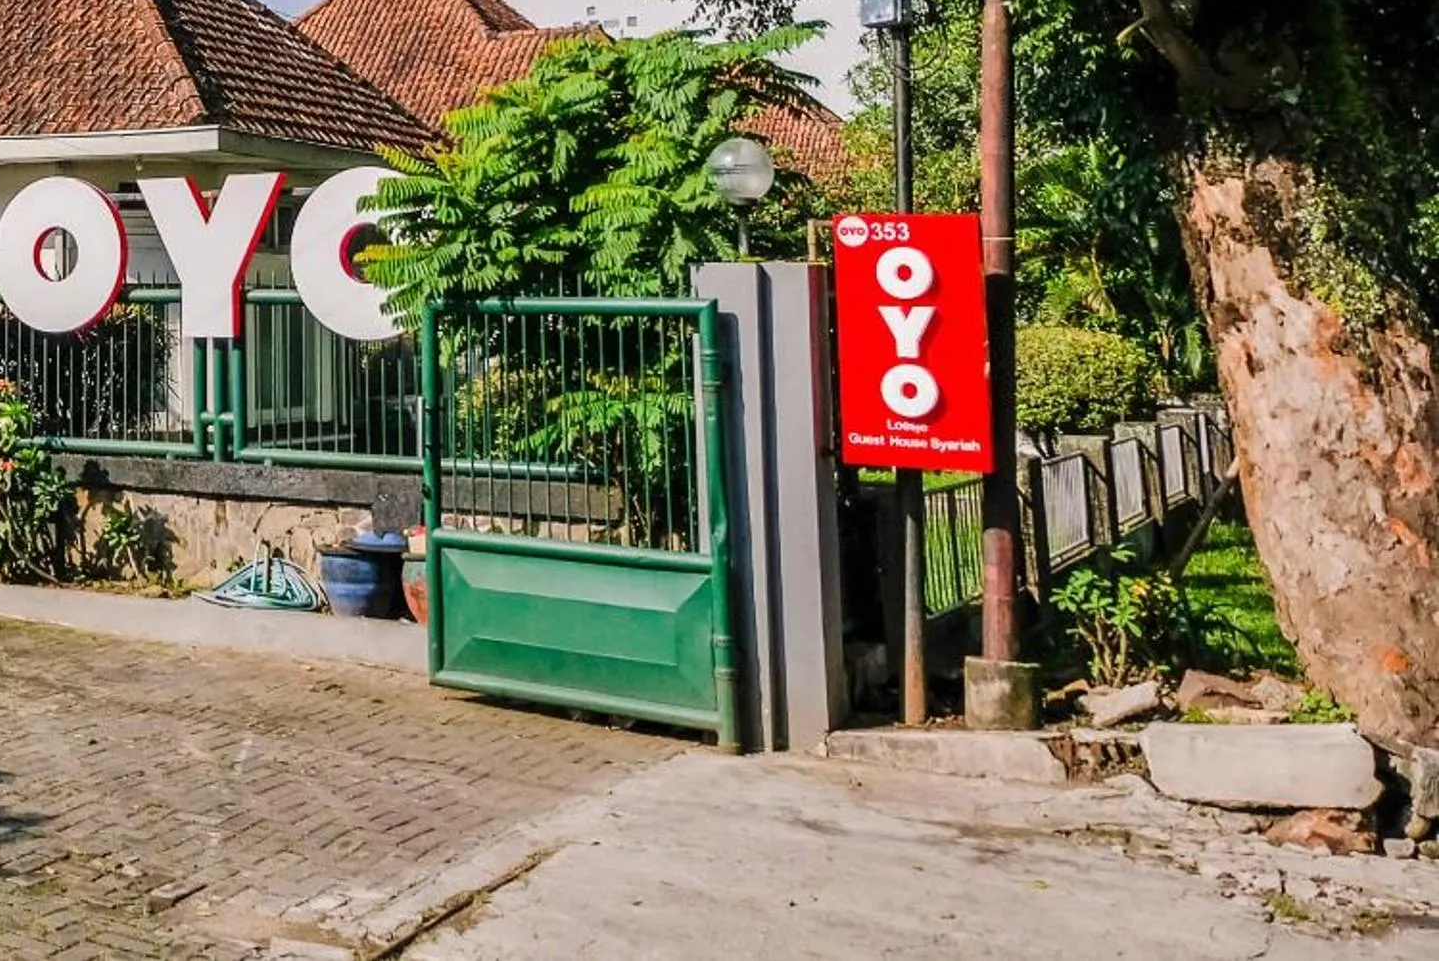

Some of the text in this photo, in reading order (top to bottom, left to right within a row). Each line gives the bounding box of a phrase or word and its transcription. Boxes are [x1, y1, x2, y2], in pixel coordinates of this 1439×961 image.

[839, 221, 911, 242] OYO 353
[875, 245, 941, 419] OYO
[848, 432, 981, 454] Guest House Syariah
